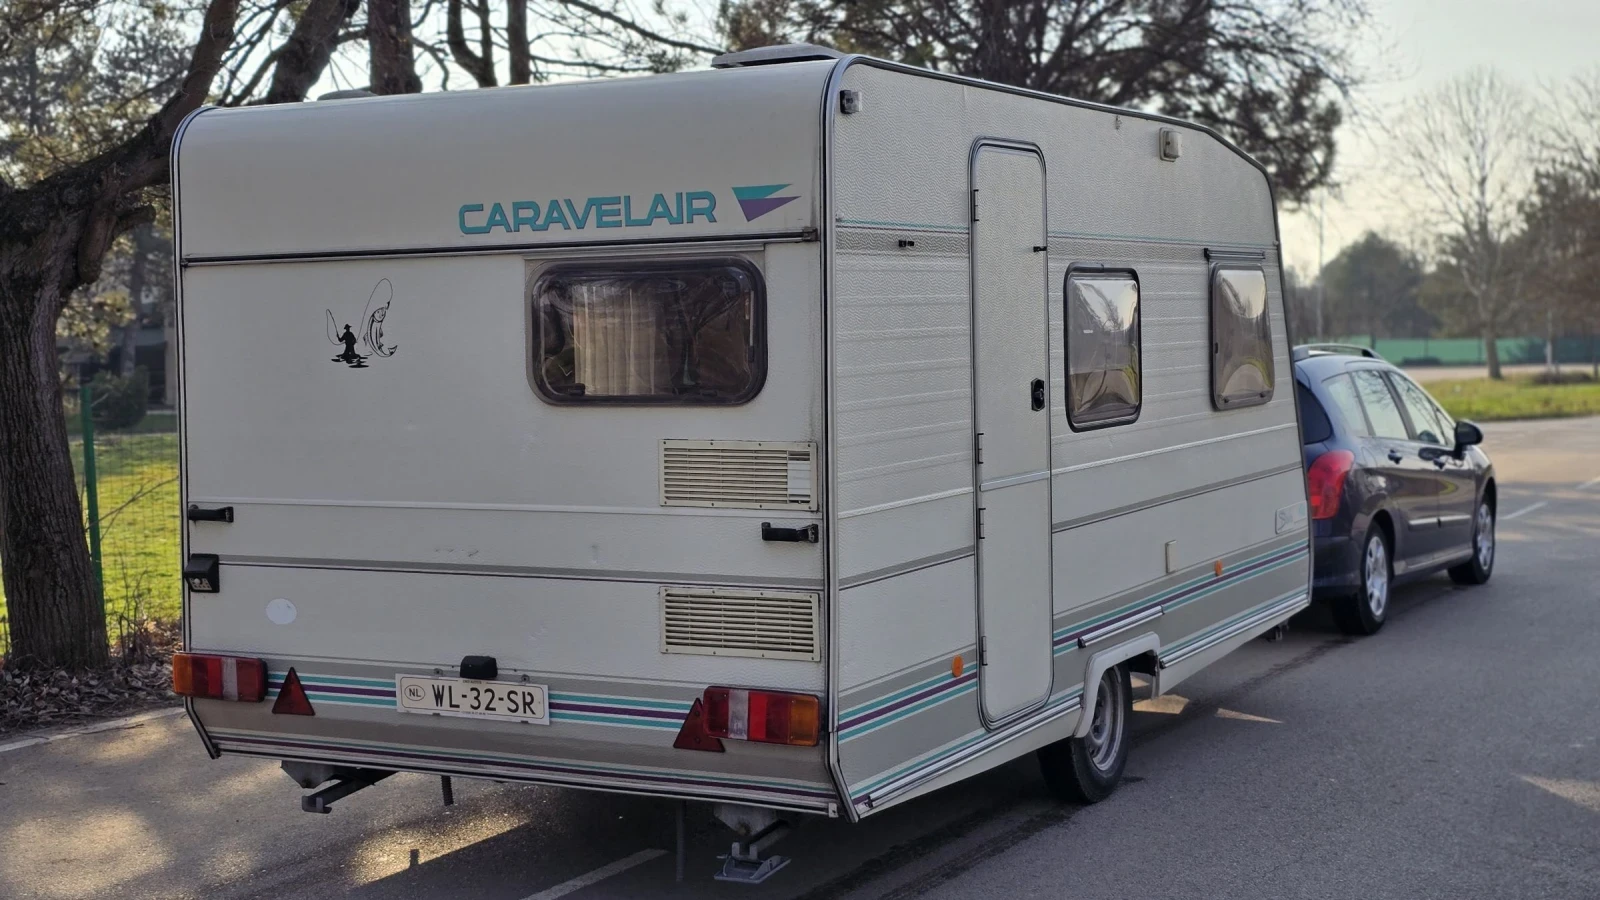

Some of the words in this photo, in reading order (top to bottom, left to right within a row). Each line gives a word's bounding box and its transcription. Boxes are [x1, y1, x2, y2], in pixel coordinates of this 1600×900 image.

[458, 190, 718, 235] CARAVELAIR
[408, 688, 422, 698] NL
[431, 684, 537, 716] WL-32-SR
